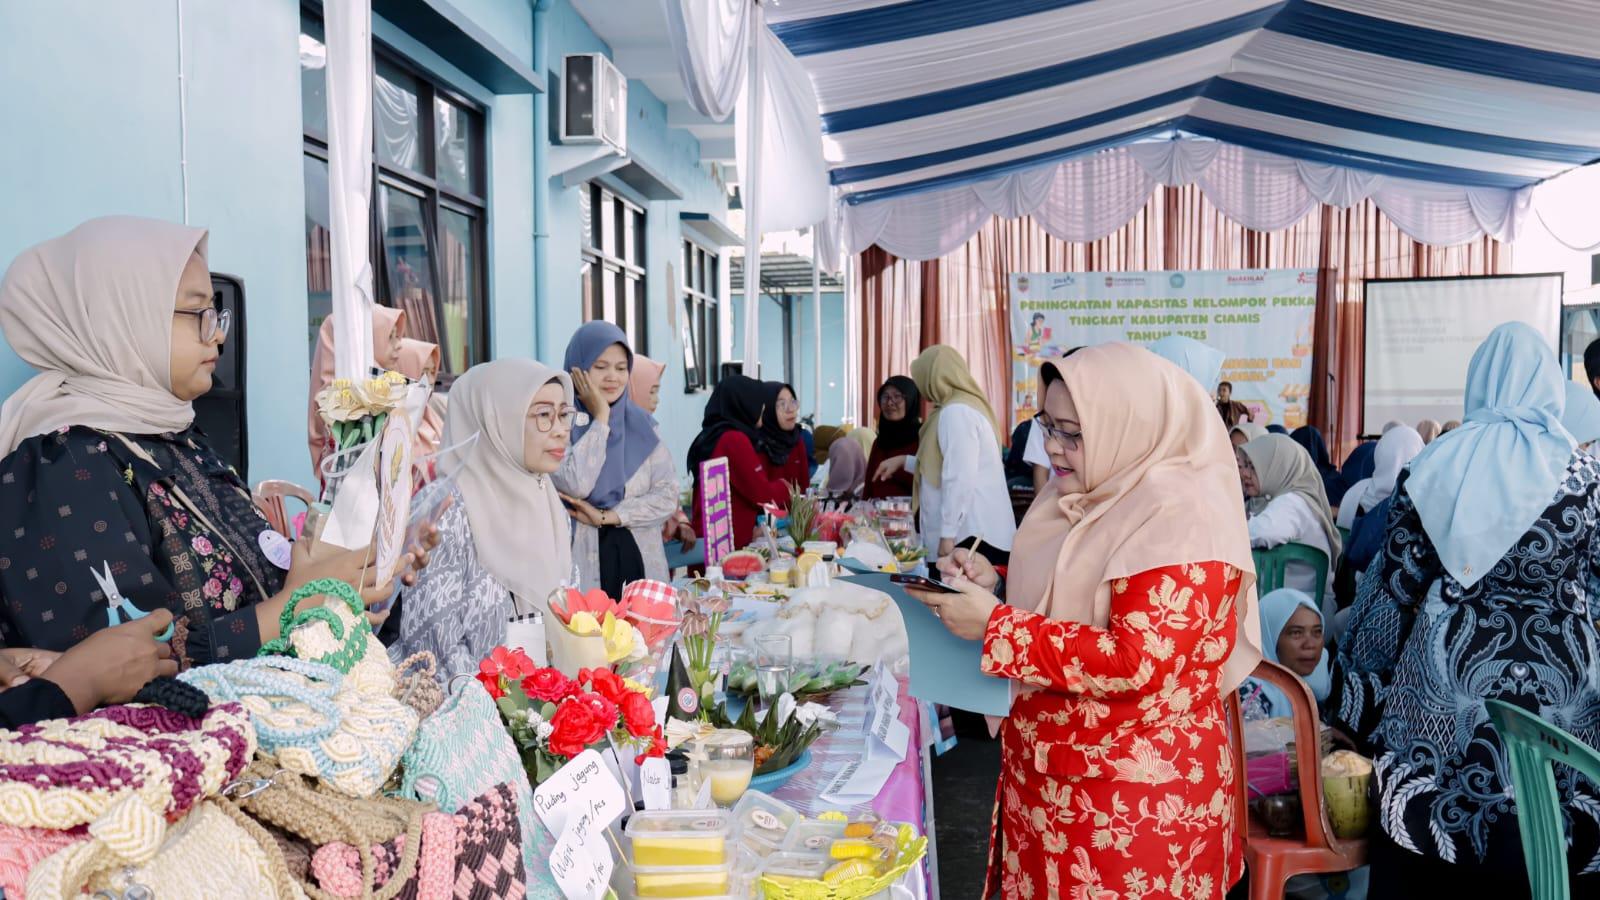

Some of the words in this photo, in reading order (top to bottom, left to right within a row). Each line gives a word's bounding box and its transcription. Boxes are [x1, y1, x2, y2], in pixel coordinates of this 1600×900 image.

[1020, 299, 1112, 311] PENINGKATAN
[1117, 298, 1188, 309] KAPASITAS
[1193, 297, 1267, 308] KELOMPOK
[1272, 296, 1316, 307] PEKKA
[1069, 315, 1125, 325] TINGKAT
[1131, 314, 1208, 325] KABUPATEN
[1214, 313, 1261, 323] CIAMIS
[535, 791, 567, 814] Puding
[570, 761, 599, 791] jagung
